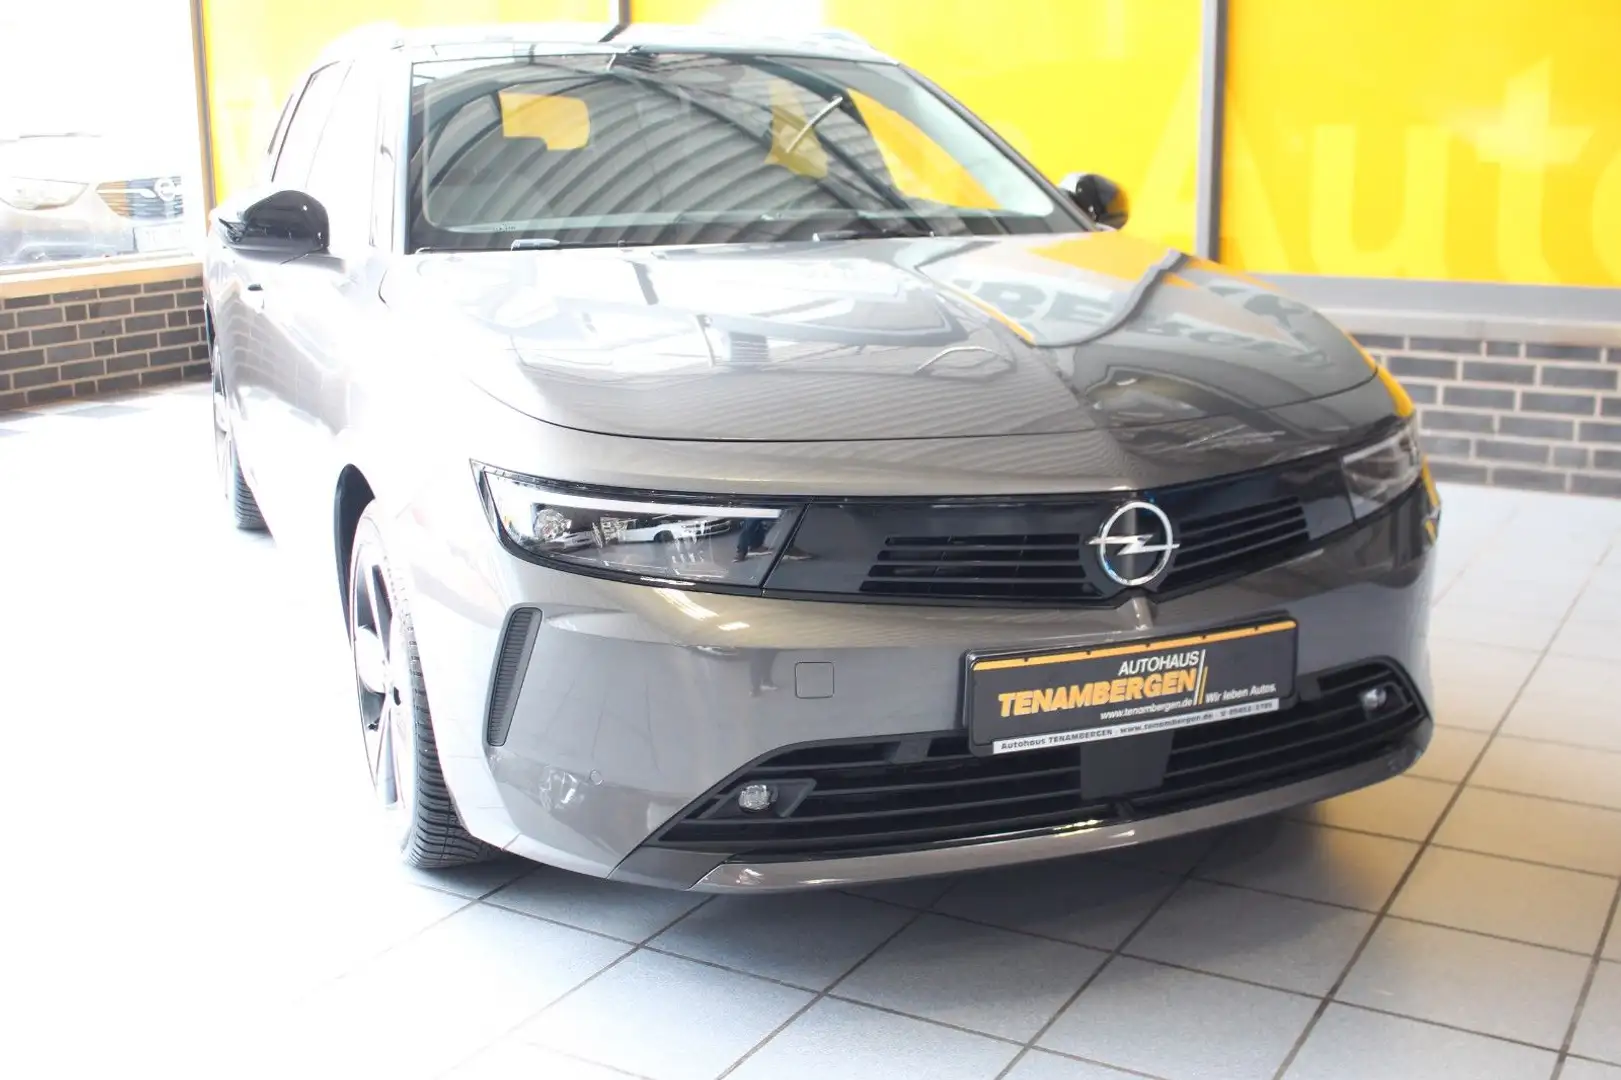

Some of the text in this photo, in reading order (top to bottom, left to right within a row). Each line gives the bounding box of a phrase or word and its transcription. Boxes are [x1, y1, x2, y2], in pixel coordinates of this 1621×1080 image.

[1128, 56, 1621, 284] Aut
[1118, 650, 1200, 676] AUTOHAUS
[998, 667, 1197, 718] TENAMBERGEN
[1205, 692, 1222, 703] Wir
[1100, 697, 1194, 720] www.tenambergen.de
[1001, 739, 1046, 750] Autohaus
[1048, 729, 1113, 743] TENAMBERGEN
